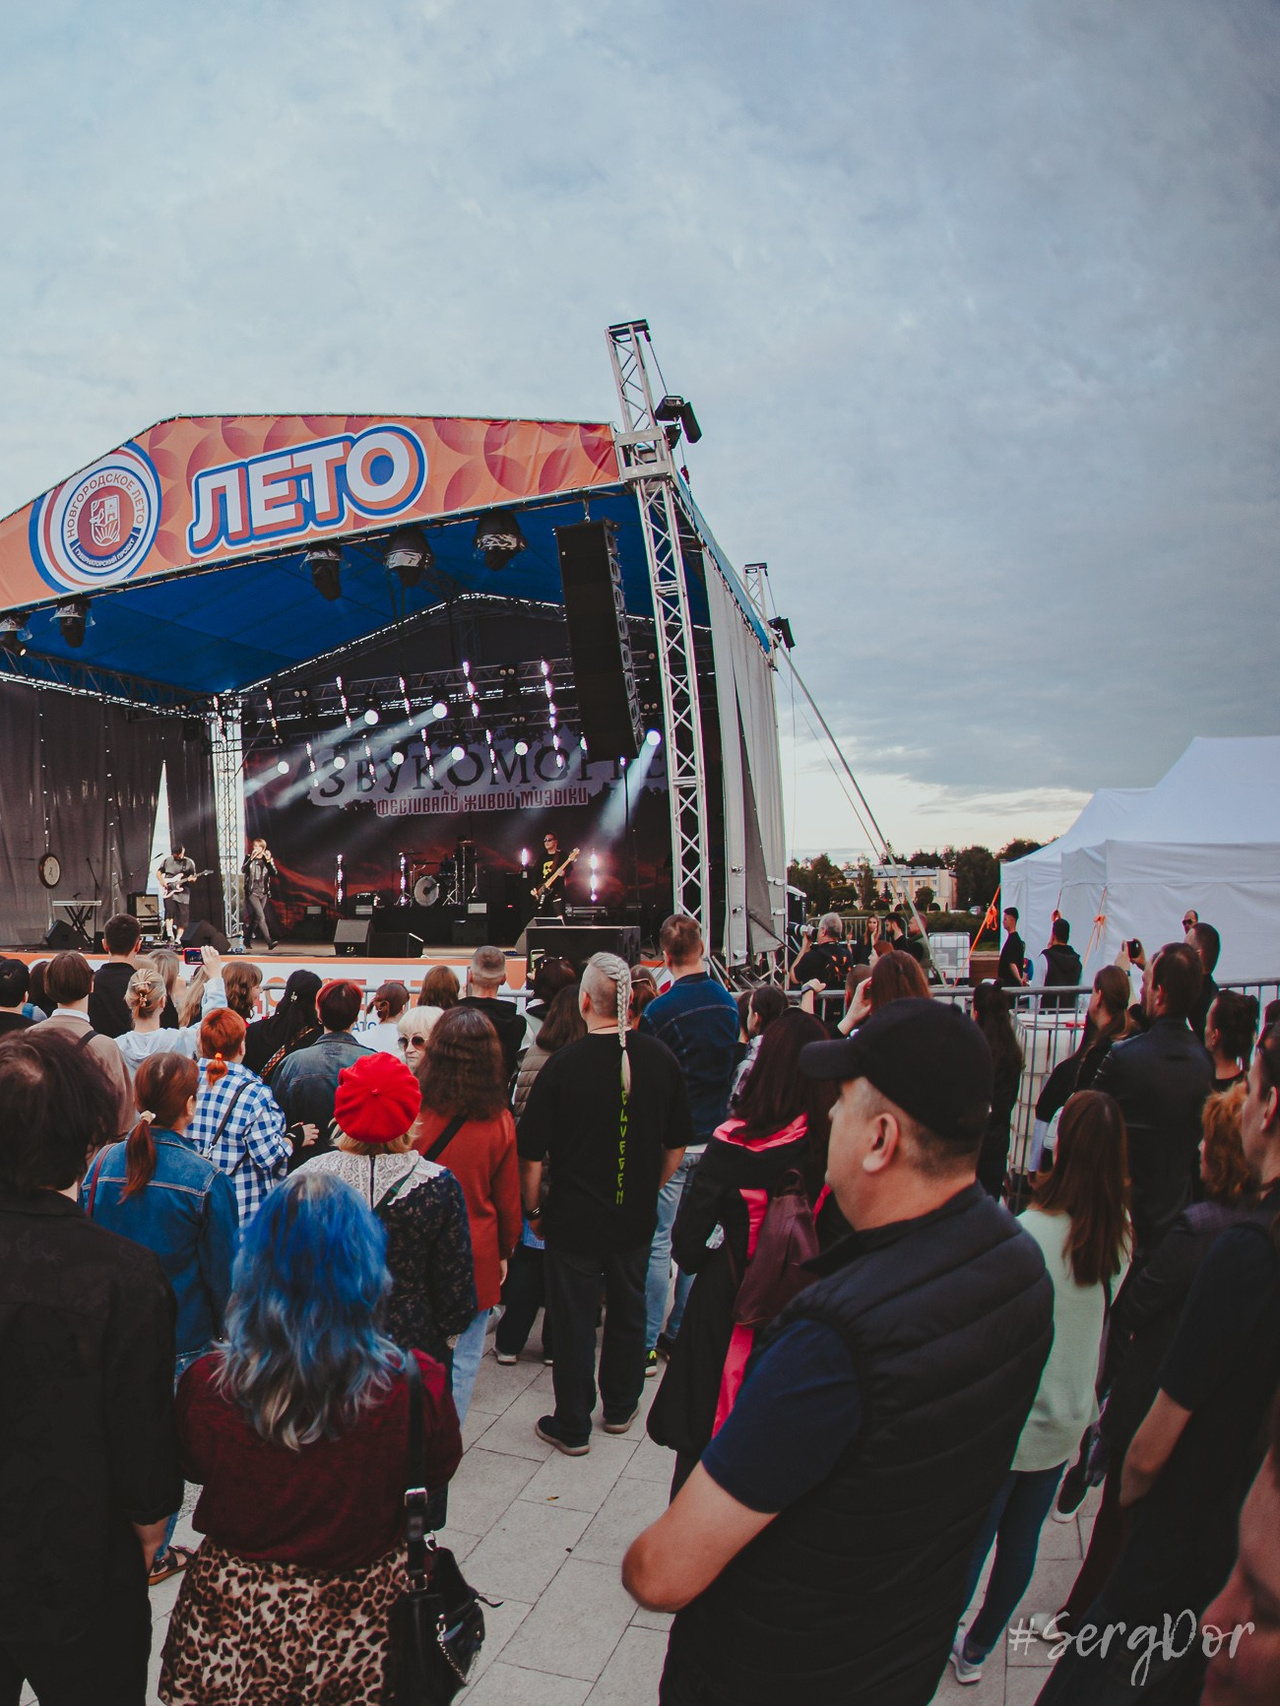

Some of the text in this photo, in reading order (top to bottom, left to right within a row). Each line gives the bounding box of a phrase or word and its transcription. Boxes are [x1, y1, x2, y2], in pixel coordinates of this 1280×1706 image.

[66, 473, 145, 539] НОВГОРОДСКОЕ ЛЕТО
[190, 430, 420, 548] ЛЕТО
[376, 786, 589, 817] ФЕСТИВАЛЬ ЖИВОЙ МУЗЫКИ
[615, 1070, 629, 1205] ELVEGEN
